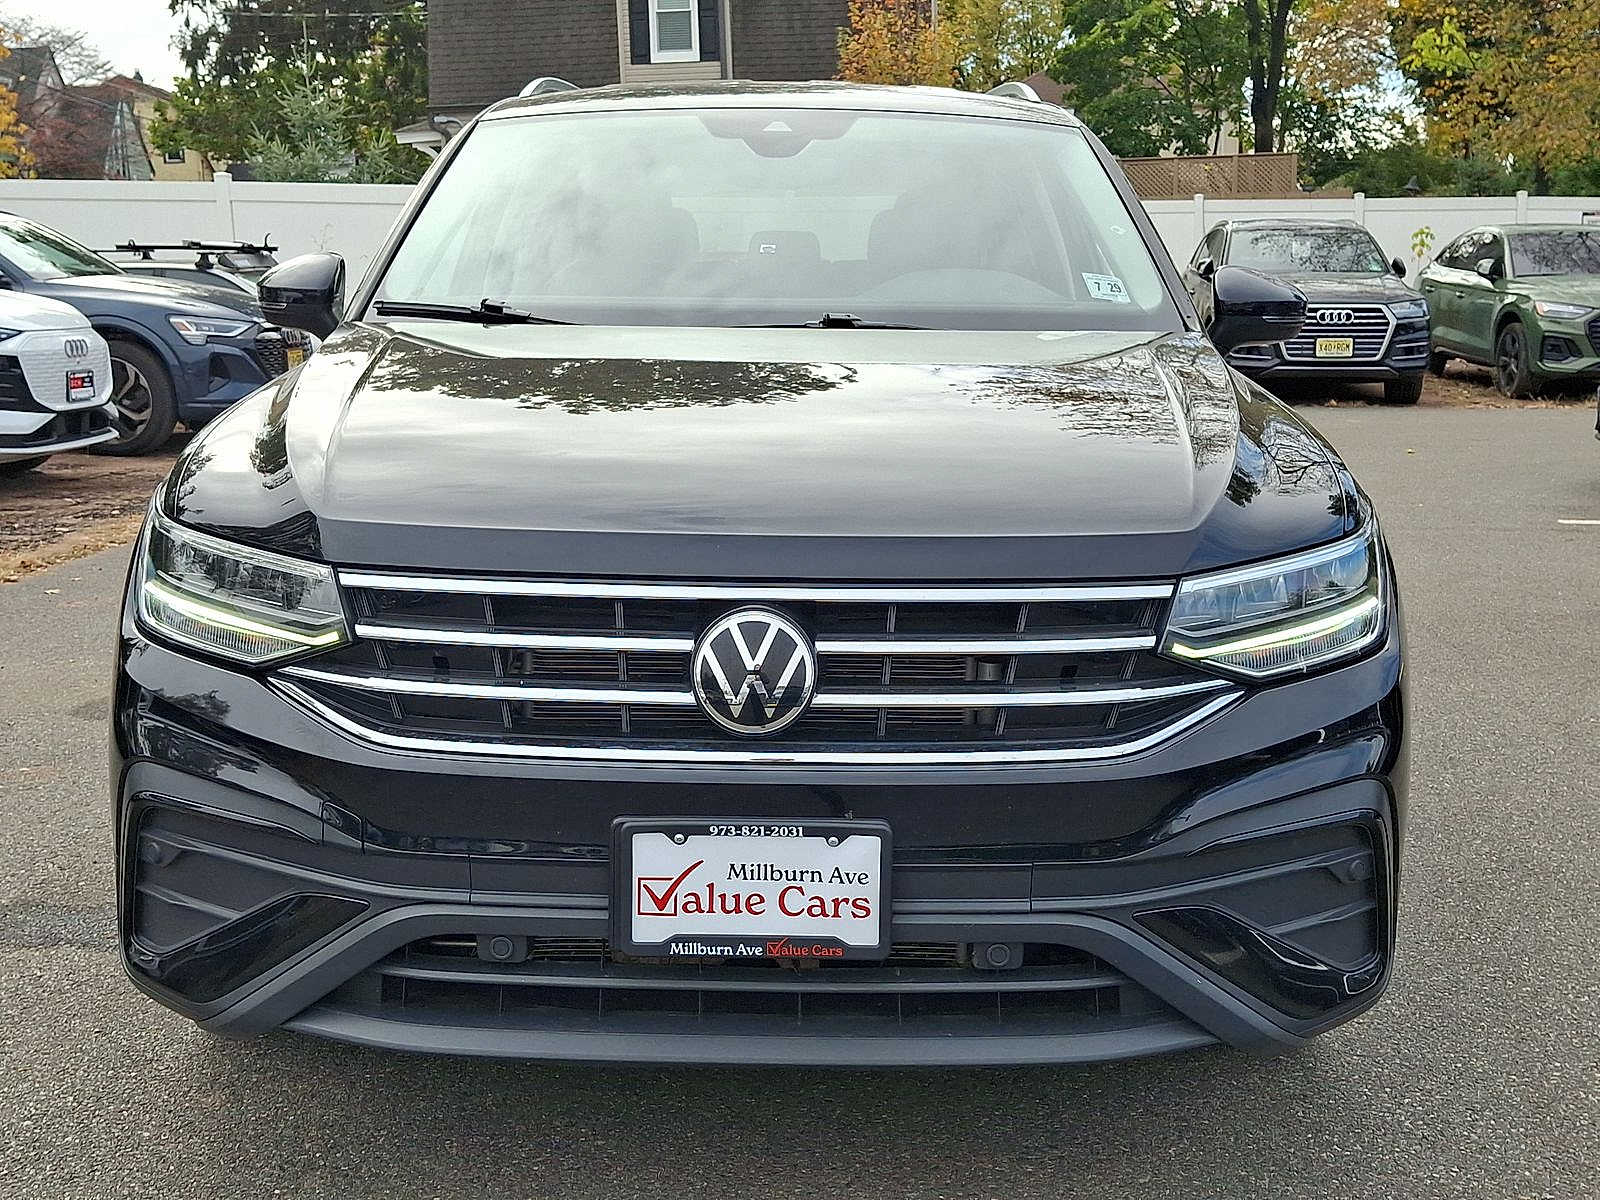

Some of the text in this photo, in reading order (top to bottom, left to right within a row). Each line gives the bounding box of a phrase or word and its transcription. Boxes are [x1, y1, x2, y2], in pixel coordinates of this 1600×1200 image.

[710, 826, 803, 837] 973-821-2031
[727, 864, 869, 885] Millburn Ave
[778, 886, 871, 918] Cars
[670, 943, 733, 956] Millburn
[736, 944, 763, 956] Ave
[811, 945, 843, 956] Cars
